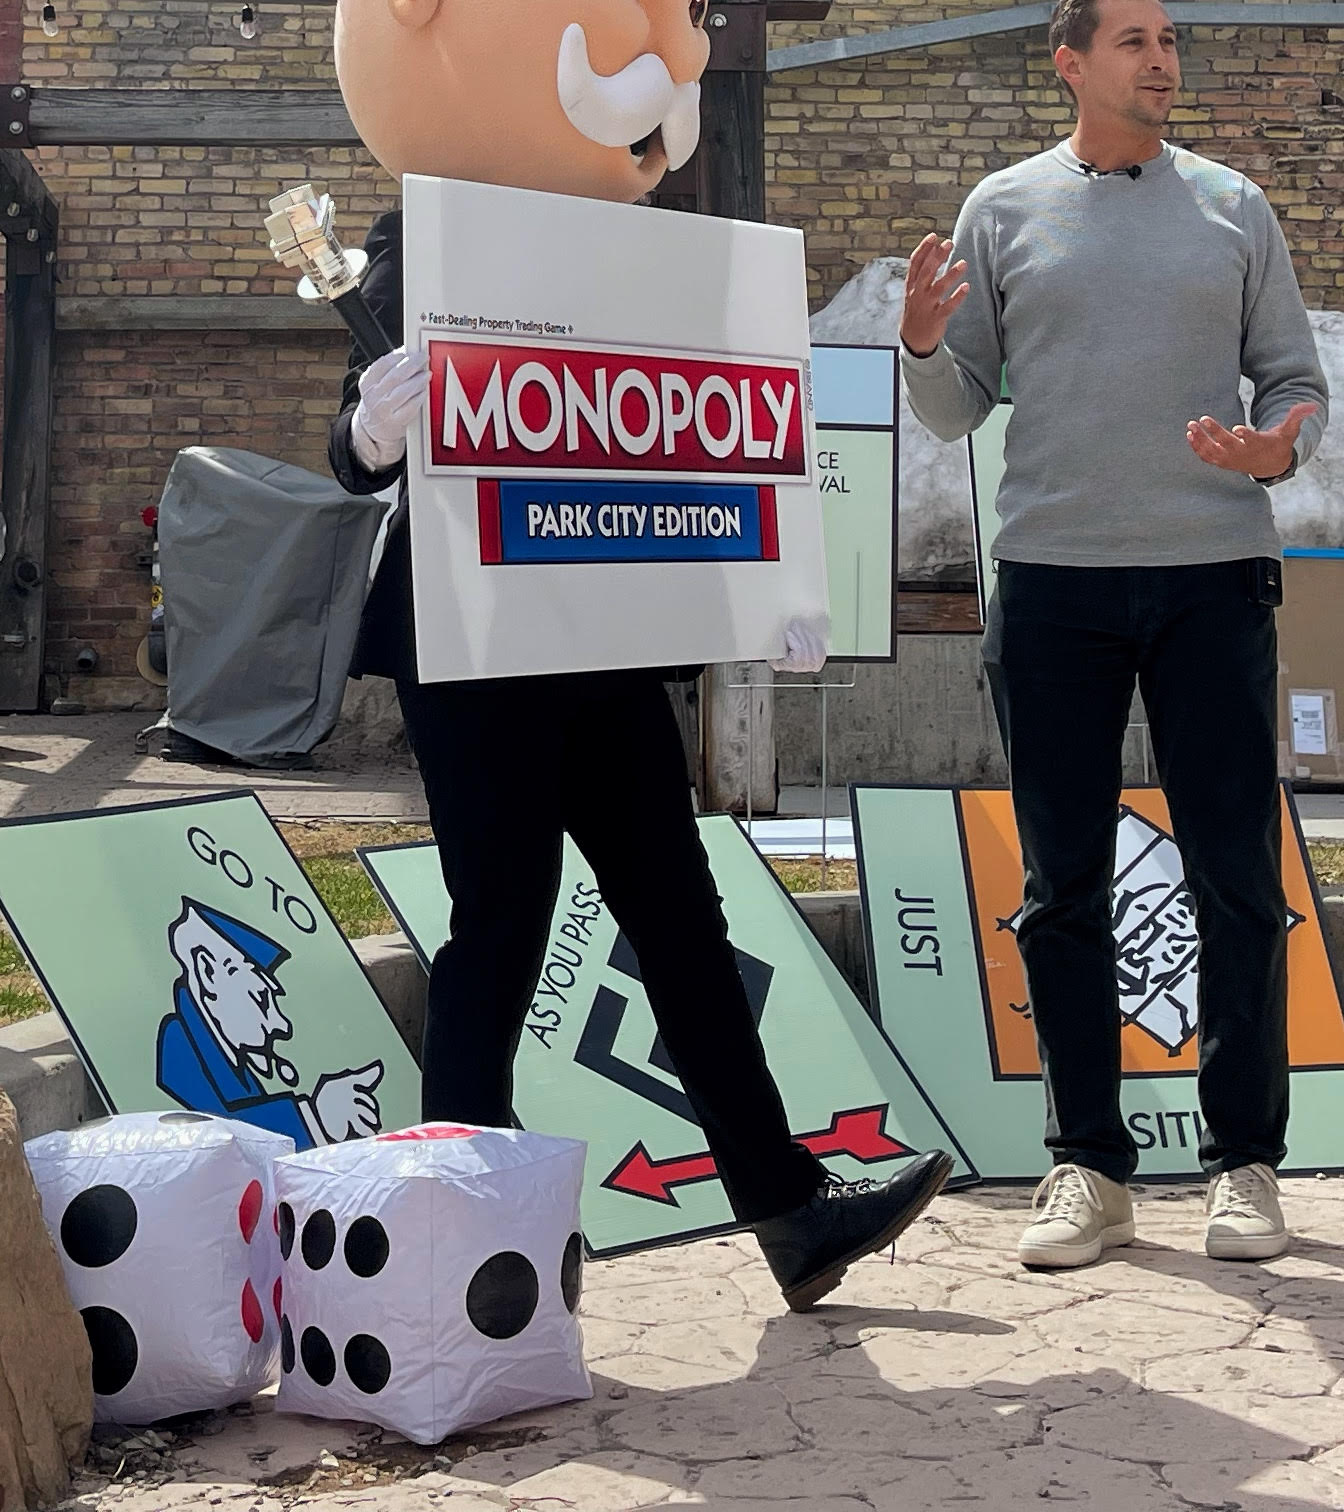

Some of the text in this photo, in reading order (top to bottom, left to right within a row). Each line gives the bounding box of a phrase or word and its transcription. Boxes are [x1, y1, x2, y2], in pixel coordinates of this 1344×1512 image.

[429, 312, 566, 334] Fast-Dealing Property Trading Game
[443, 354, 796, 460] MONOPOLY
[527, 503, 742, 538] PARK CITY EDITION
[187, 826, 317, 934] GO TO
[525, 881, 605, 1049] AS YOU PASS
[895, 888, 943, 976] JUST
